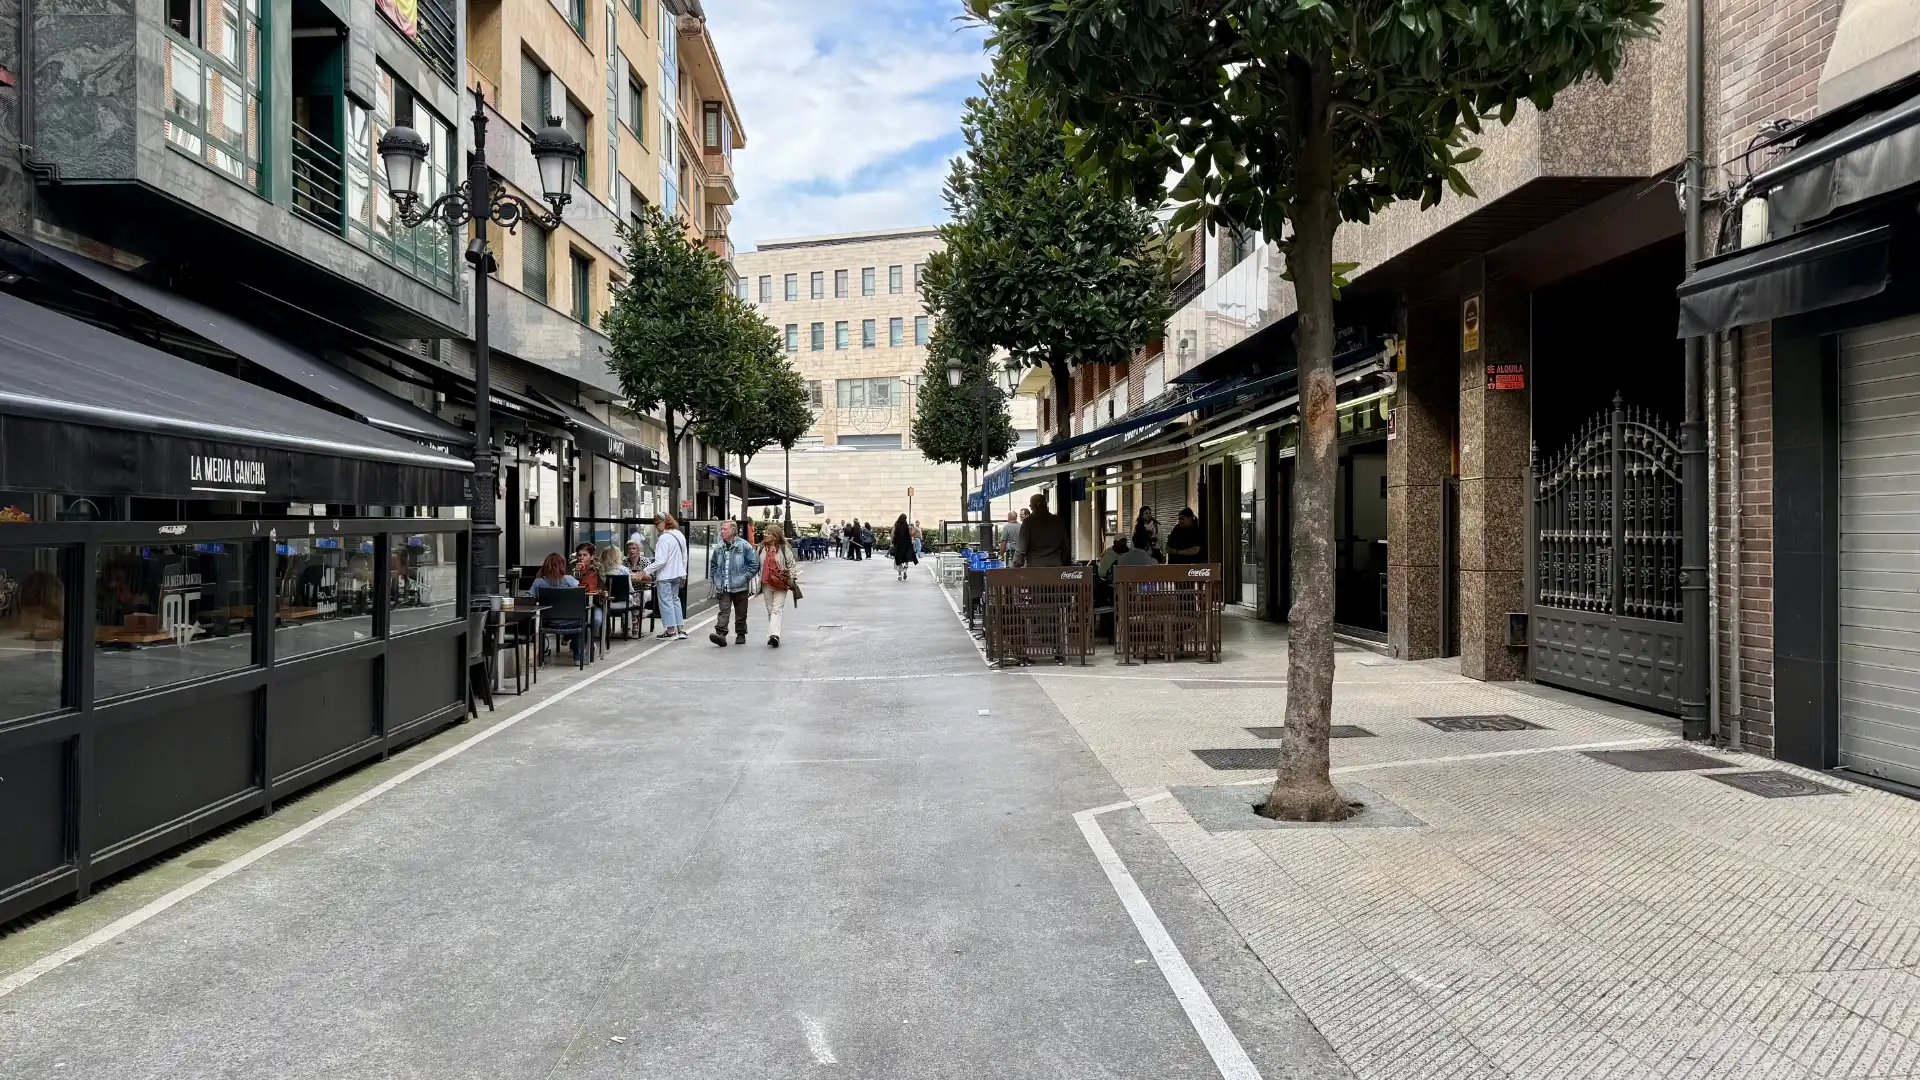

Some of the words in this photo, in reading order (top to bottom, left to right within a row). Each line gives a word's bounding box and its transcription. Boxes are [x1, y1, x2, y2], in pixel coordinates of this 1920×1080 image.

[1487, 364, 1496, 374] SE
[1496, 364, 1524, 374] ALQUILA
[190, 455, 203, 481] LA
[204, 456, 233, 483] MEDIA
[234, 459, 266, 485] CANCHA
